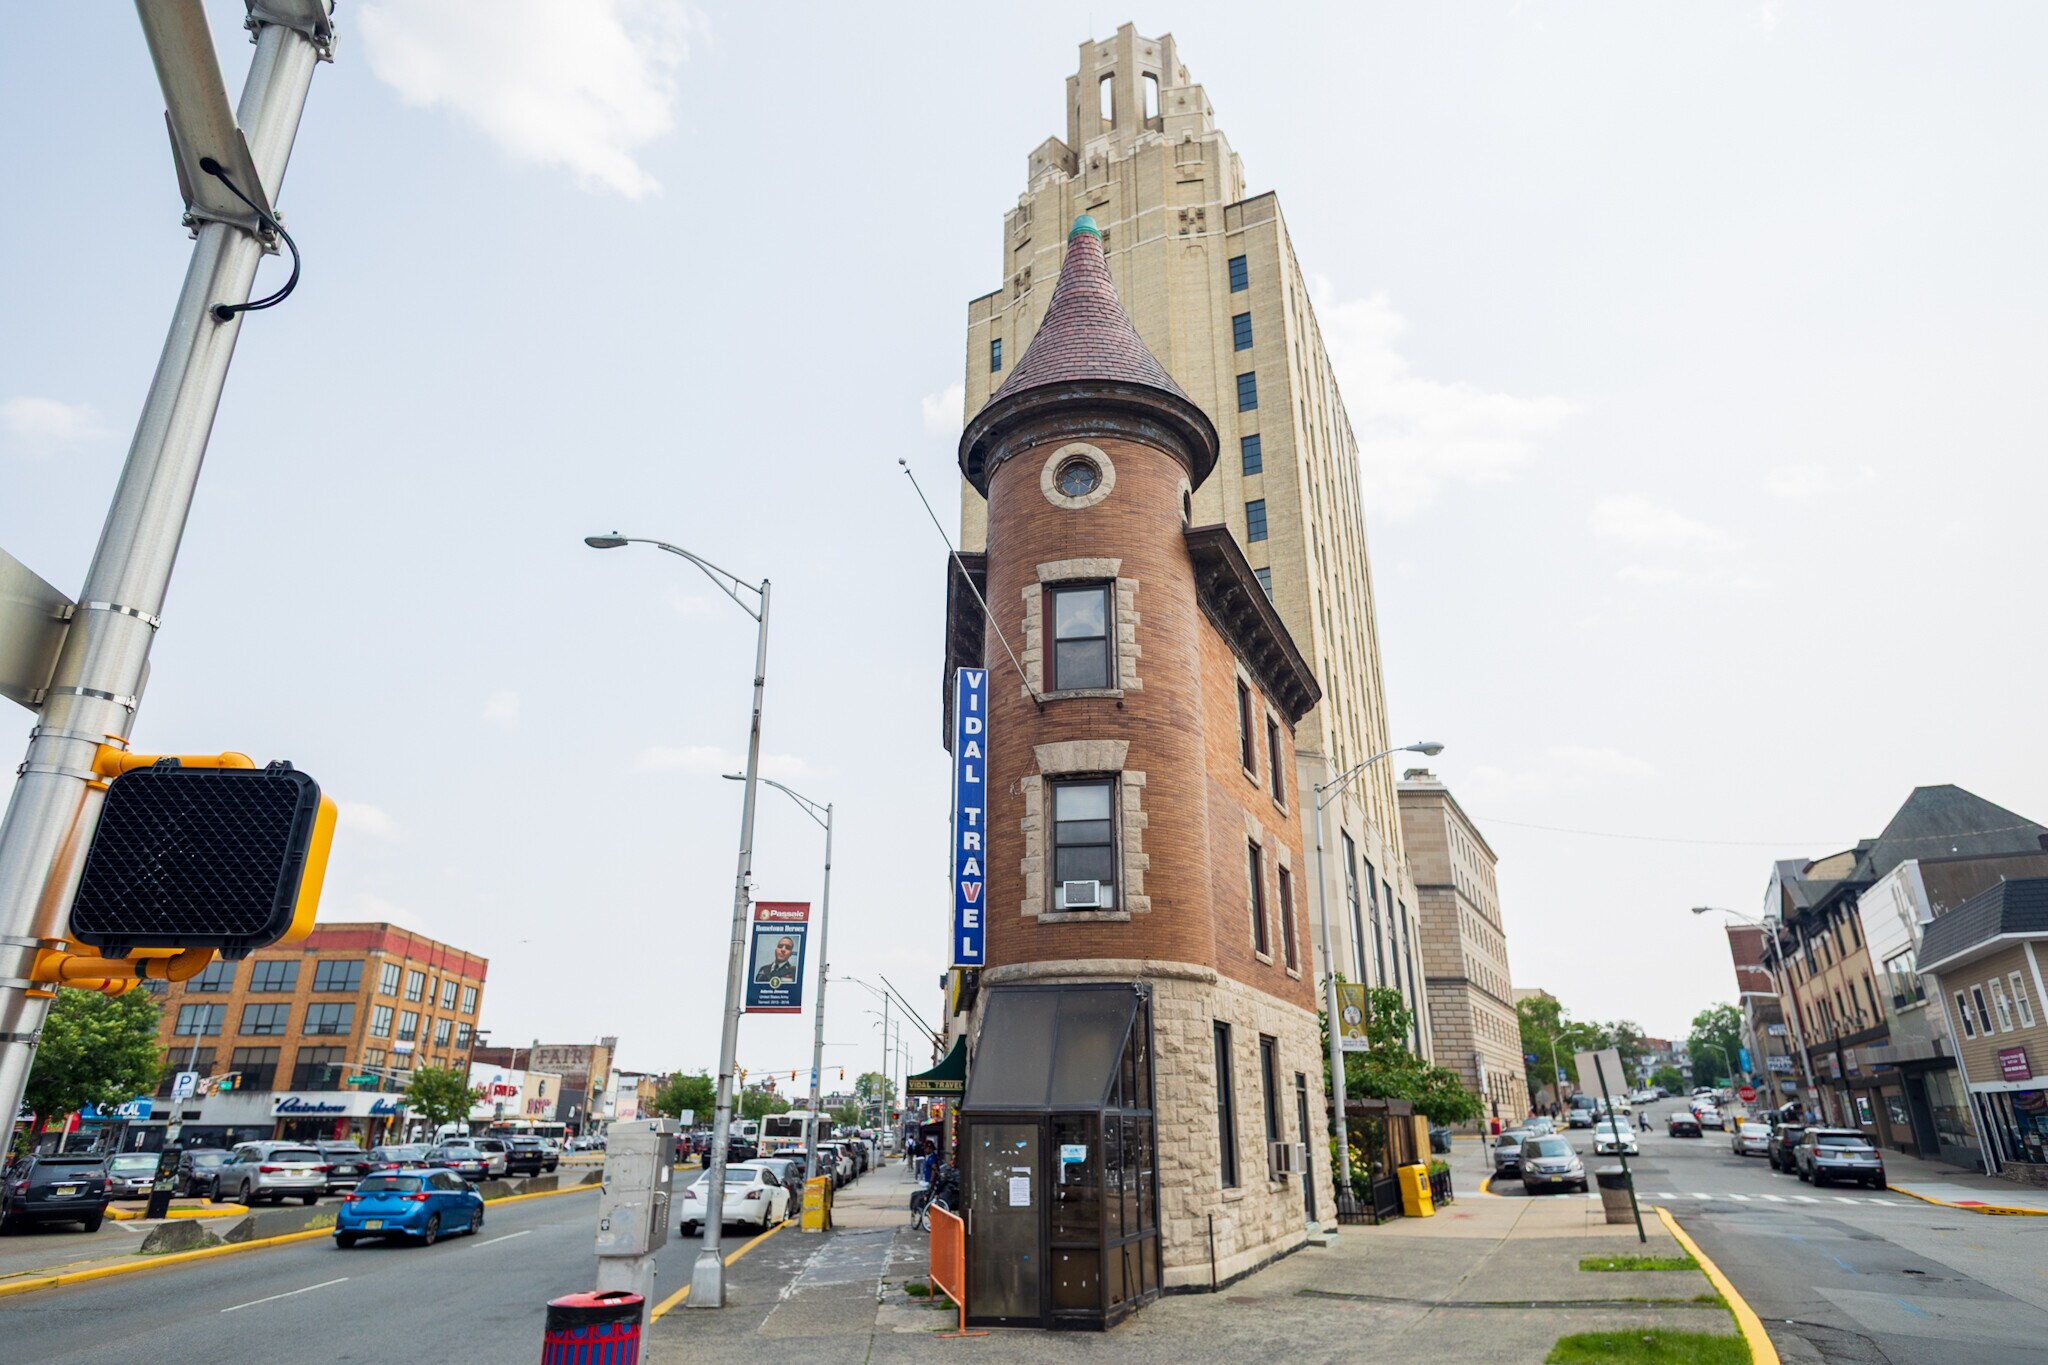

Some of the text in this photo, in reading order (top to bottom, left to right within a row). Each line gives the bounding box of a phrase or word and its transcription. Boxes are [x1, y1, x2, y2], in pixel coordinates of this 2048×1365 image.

[961, 672, 983, 957] VIDAL TRAVEL
[771, 910, 804, 918] Passaic
[539, 1049, 583, 1064] FAIR
[179, 1075, 192, 1089] P
[276, 1097, 346, 1113] Rainbow
